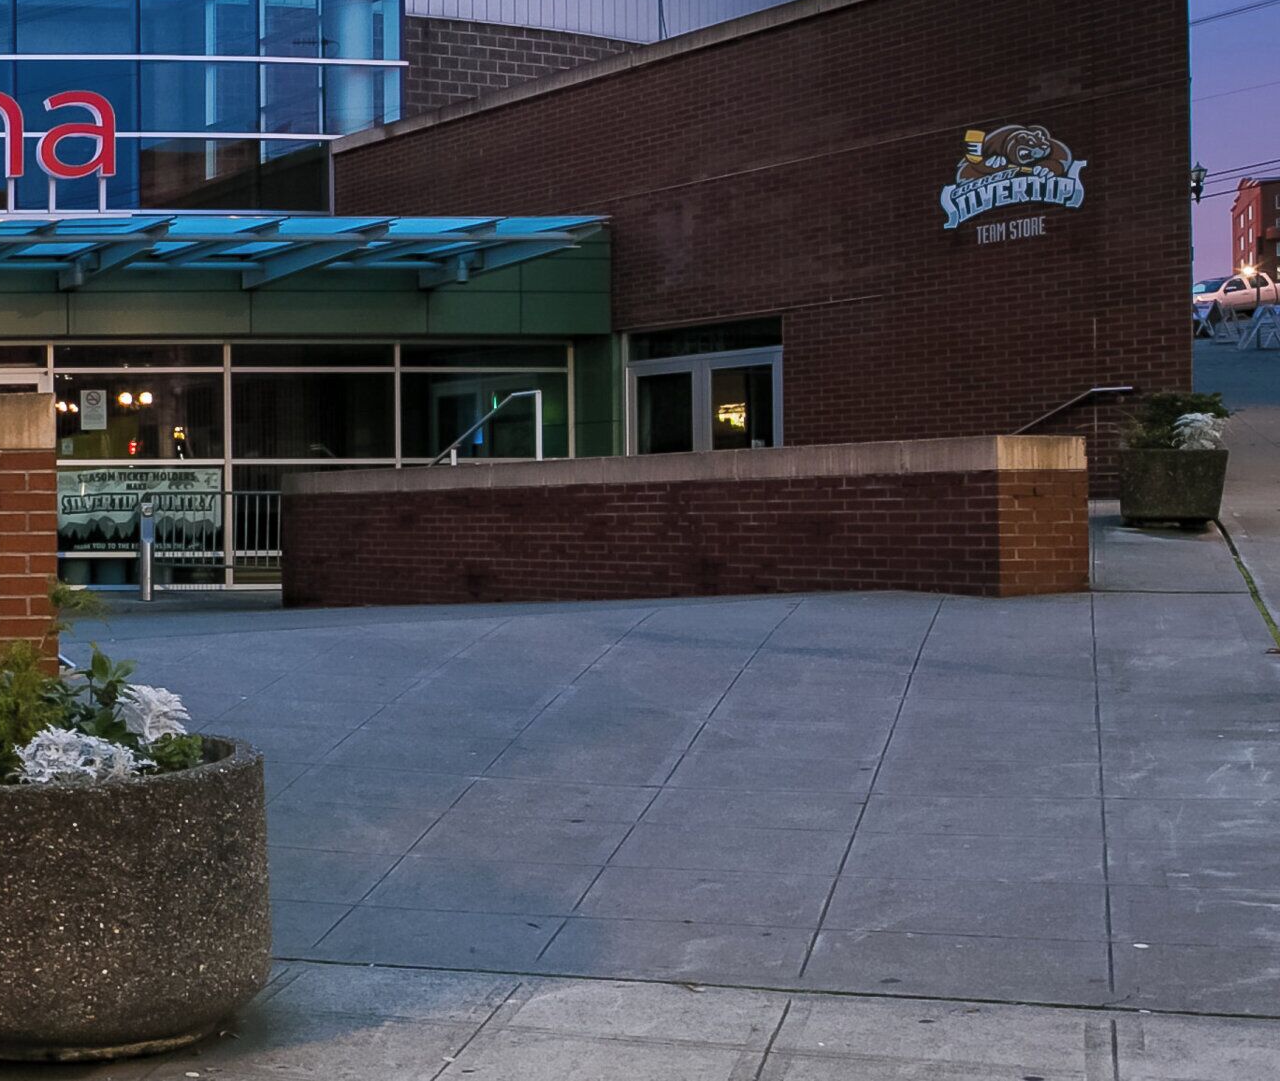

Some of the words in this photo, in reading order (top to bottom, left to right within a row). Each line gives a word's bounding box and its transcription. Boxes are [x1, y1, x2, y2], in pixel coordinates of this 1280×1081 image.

[940, 160, 1088, 229] SILVERTIPS
[976, 223, 1006, 245] TEAM
[1009, 216, 1047, 240] STORE
[118, 472, 150, 482] TICKET
[62, 494, 139, 514] SILVERTIP
[143, 494, 214, 512] OUNTRY
